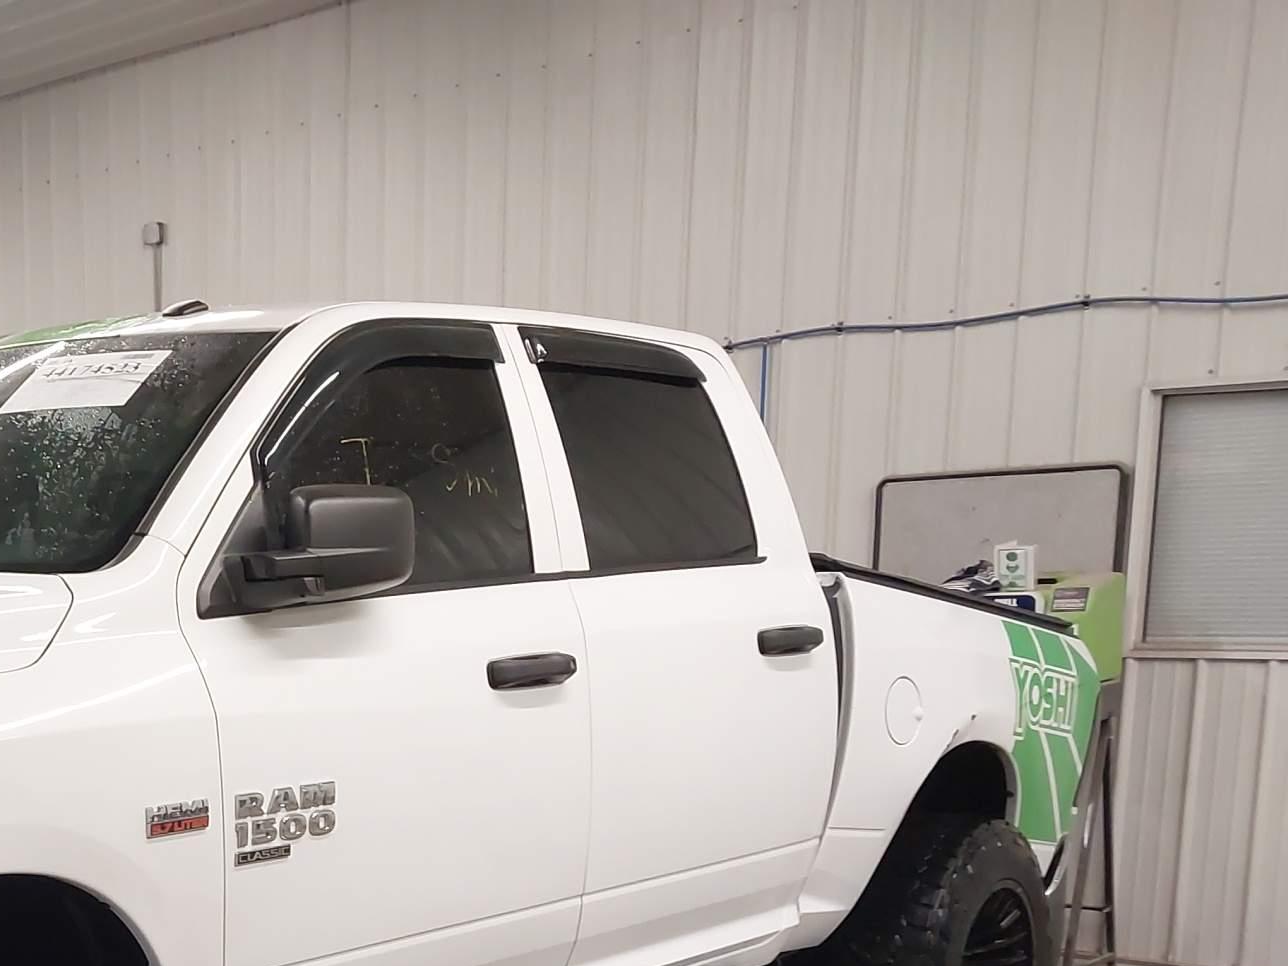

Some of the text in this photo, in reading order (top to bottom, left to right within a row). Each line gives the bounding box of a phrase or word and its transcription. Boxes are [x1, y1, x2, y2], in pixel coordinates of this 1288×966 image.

[1011, 660, 1077, 738] YOSHI
[146, 798, 209, 823] HEMI
[234, 781, 336, 818] RAM
[235, 809, 336, 848] 1500
[238, 846, 290, 864] CLASSIC
